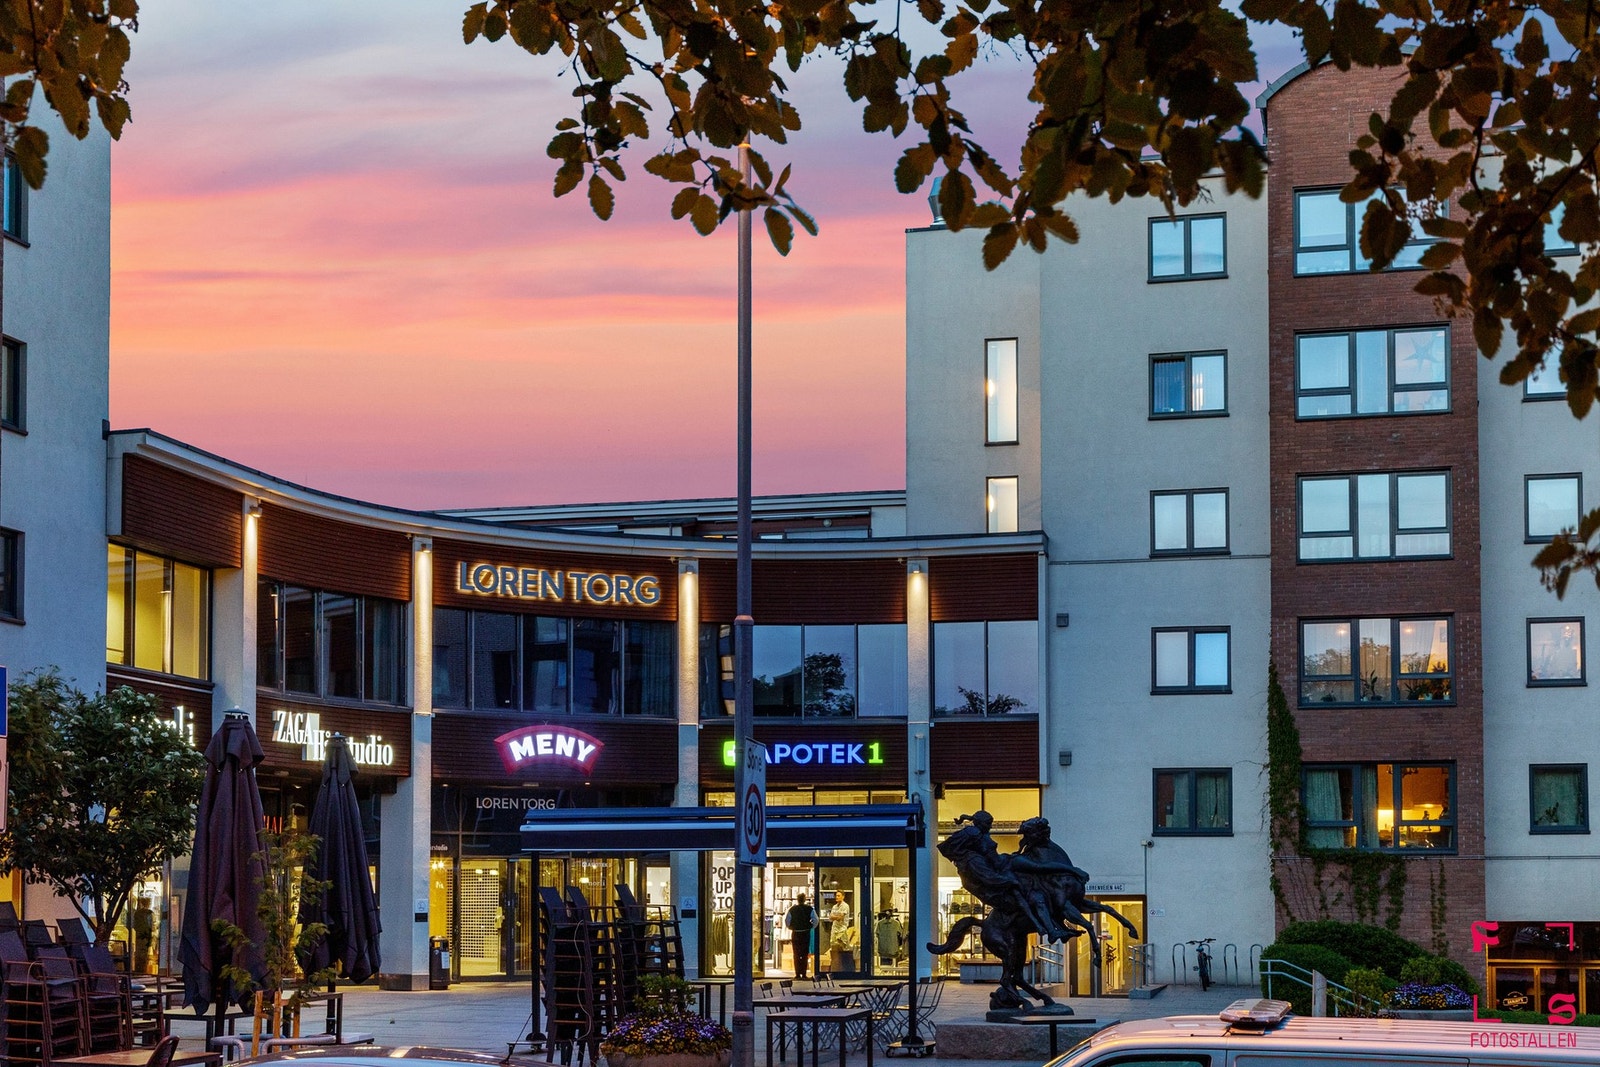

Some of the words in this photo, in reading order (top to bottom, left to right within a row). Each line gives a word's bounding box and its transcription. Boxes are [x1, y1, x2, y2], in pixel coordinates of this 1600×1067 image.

[458, 560, 564, 601] LØREN
[569, 571, 661, 605] TORG
[276, 710, 313, 745] ZAGA
[313, 729, 393, 766] Htudio
[508, 733, 596, 763] MENY
[747, 747, 763, 773] Sone
[868, 742, 884, 765] 1
[520, 797, 556, 811] TORG
[747, 802, 761, 837] 30
[711, 896, 734, 909] STO
